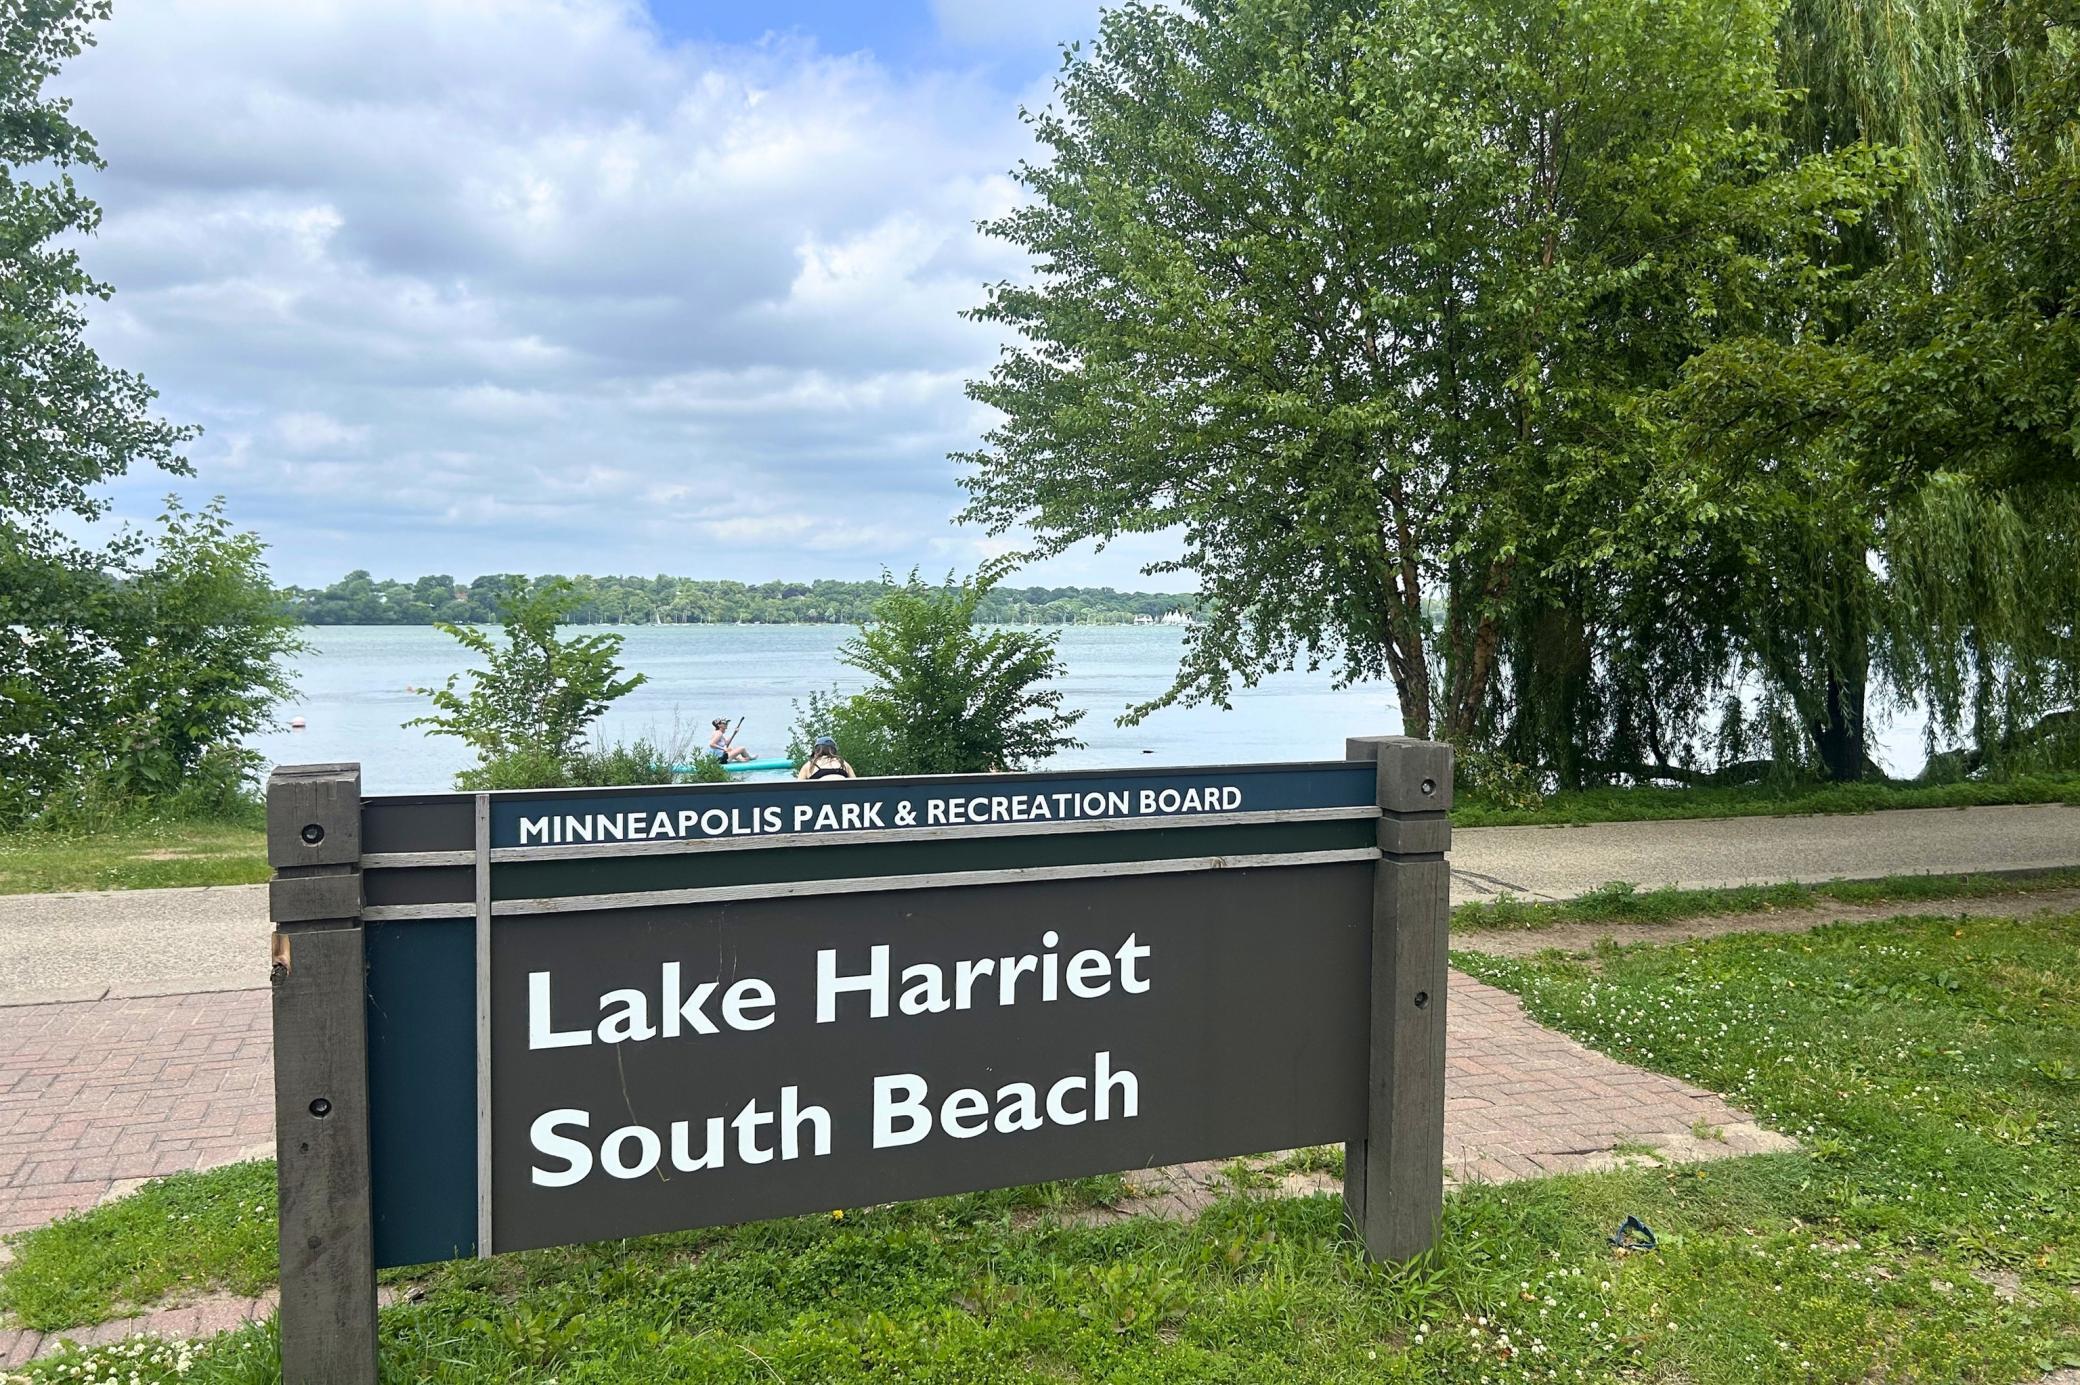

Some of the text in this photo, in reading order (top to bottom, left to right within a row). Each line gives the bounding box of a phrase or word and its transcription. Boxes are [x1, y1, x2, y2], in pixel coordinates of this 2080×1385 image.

[520, 786, 1242, 845] MINNEAPOLIS PARK & RECREATION BOARD
[528, 930, 1151, 1050] Lake Harriet
[530, 1050, 1139, 1187] South Beach
